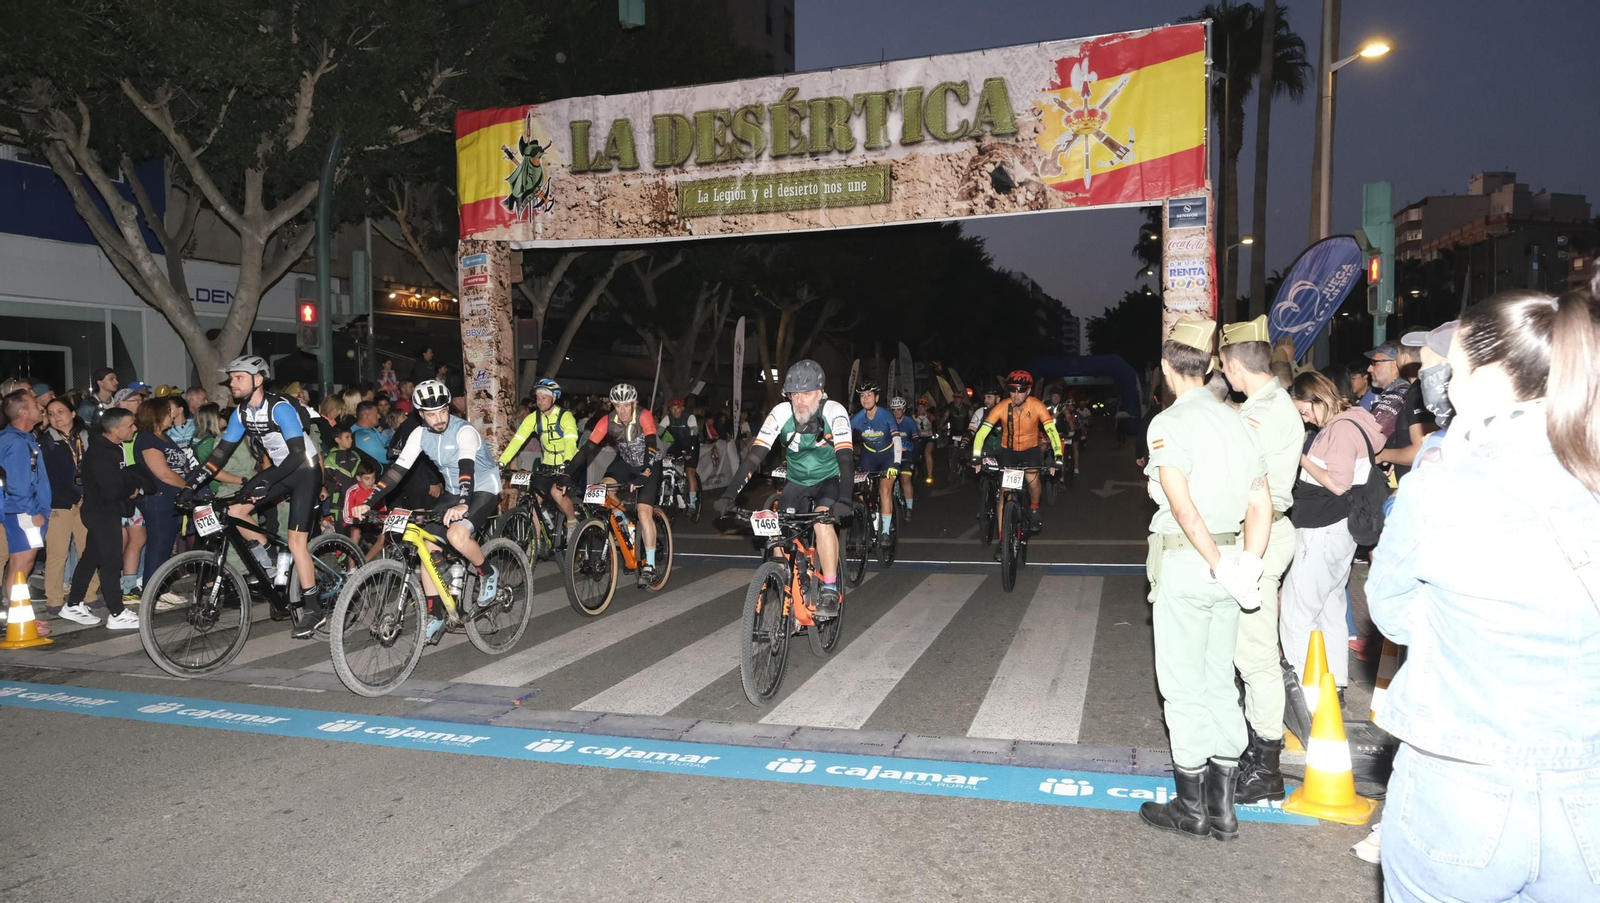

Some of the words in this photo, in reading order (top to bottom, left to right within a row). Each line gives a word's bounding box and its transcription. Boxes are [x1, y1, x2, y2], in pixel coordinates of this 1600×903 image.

[570, 118, 640, 173] LA
[652, 77, 1019, 167] DESÉRTICA
[698, 190, 709, 203] La
[713, 187, 746, 204] Legión
[752, 188, 758, 201] y
[764, 184, 773, 198] el
[778, 182, 818, 197] desierto
[824, 182, 842, 194] nos
[848, 181, 867, 192] une
[1169, 267, 1206, 277] RENTA
[466, 328, 487, 337] BBVA
[1006, 475, 1022, 485] 7187
[197, 514, 216, 529] 6726
[755, 519, 777, 530] 7466
[17, 692, 118, 706] cajamar
[177, 708, 291, 724] cajamar
[364, 726, 491, 745] cajamar
[577, 745, 721, 765] cajamar
[638, 758, 666, 766] CAJA
[668, 760, 707, 769] RURAL
[825, 765, 989, 787] cajamar
[899, 780, 935, 788] CAJA
[937, 782, 980, 790] RURAL
[1240, 806, 1291, 815] RURAL
